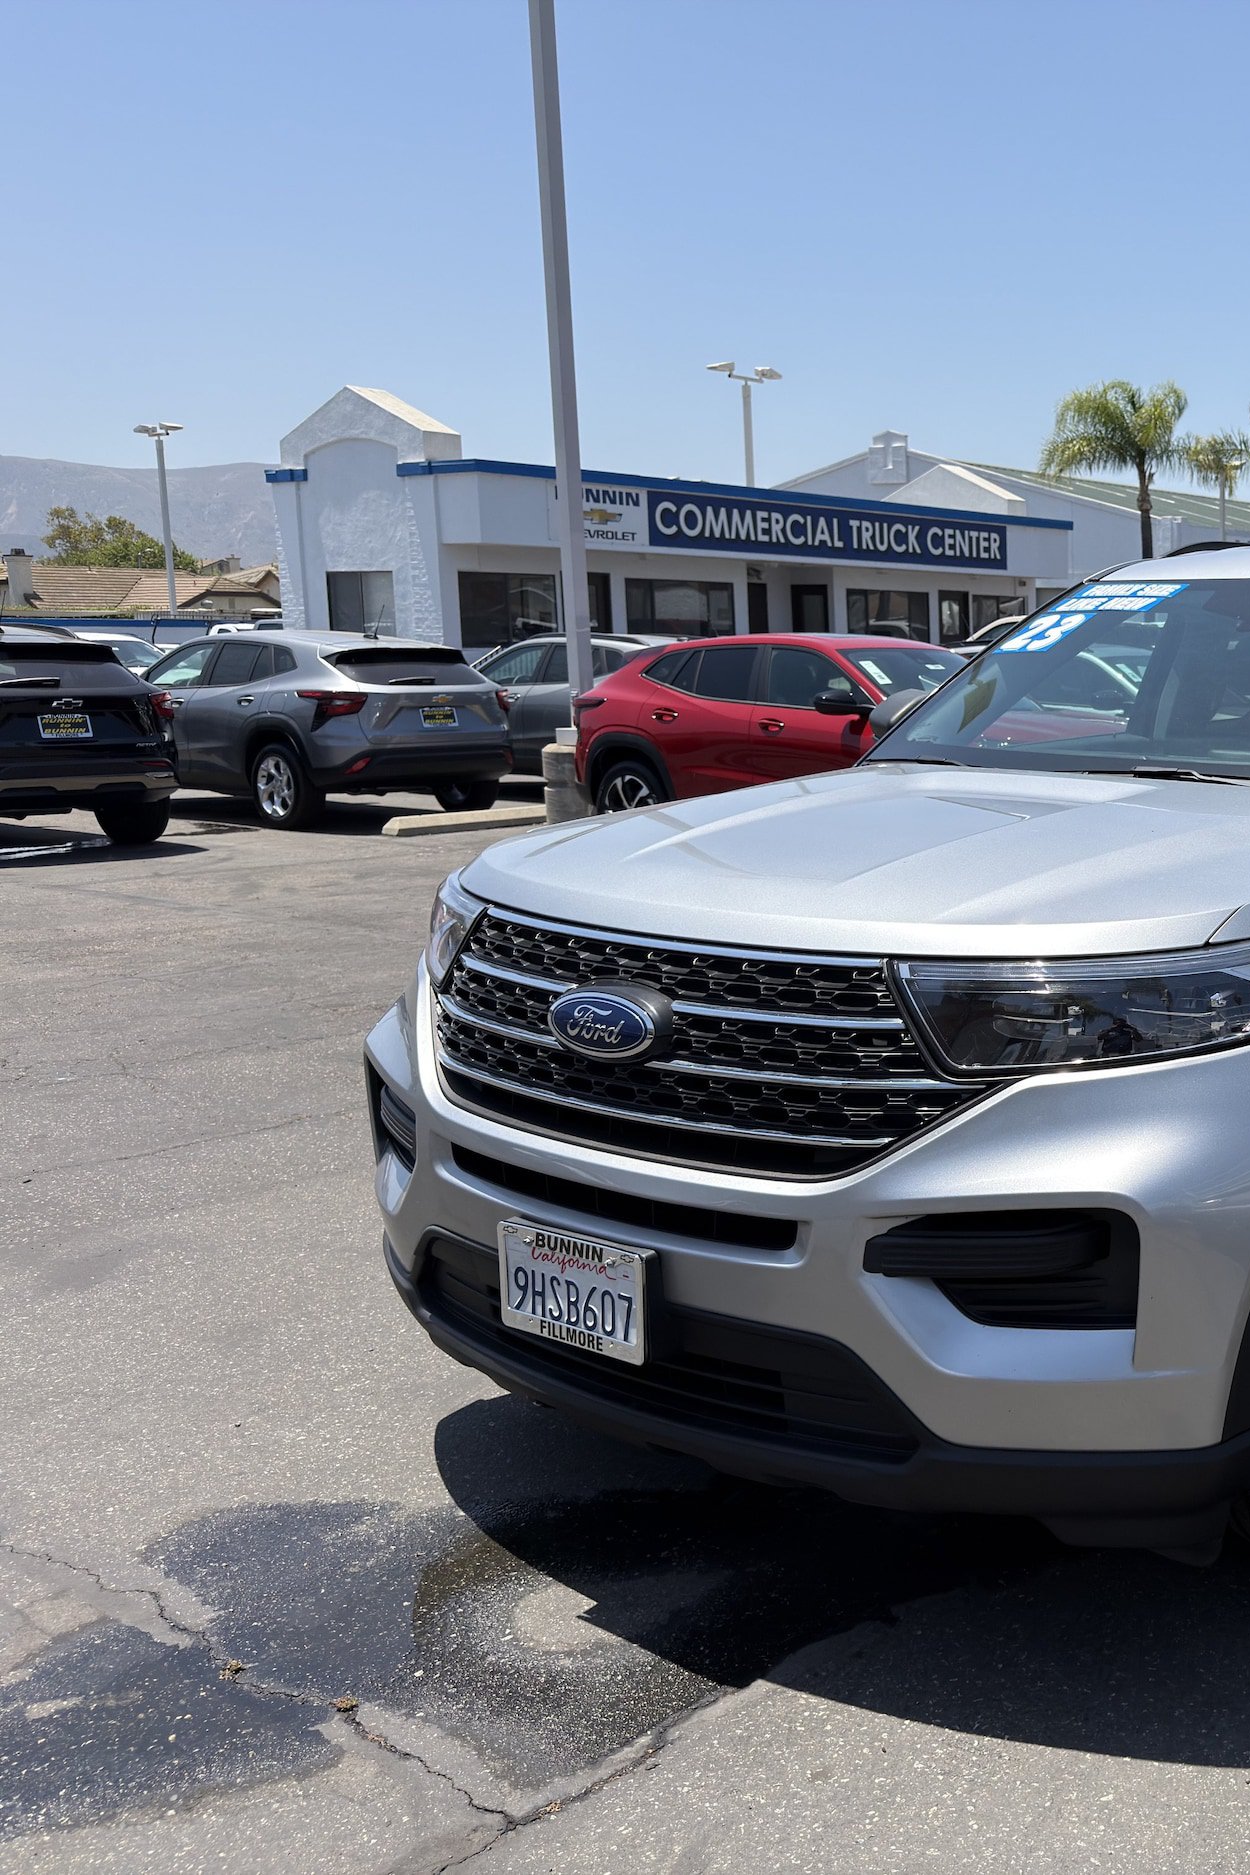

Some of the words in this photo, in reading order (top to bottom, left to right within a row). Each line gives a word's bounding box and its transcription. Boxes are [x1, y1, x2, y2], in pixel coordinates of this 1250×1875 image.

[584, 528, 638, 542] EVROLET
[653, 499, 844, 549] COMMERCIAL
[849, 518, 922, 555] TRUCK
[926, 526, 1002, 561] CENTER
[1055, 597, 1107, 612] LIKE
[1098, 597, 1155, 612] NEW
[1082, 583, 1143, 597] FAMILY
[1000, 613, 1087, 652] 23
[566, 1004, 626, 1045] Ford
[535, 1232, 604, 1262] BUNNIN
[531, 1247, 617, 1280] California
[514, 1266, 633, 1341] 9HSB607
[539, 1320, 604, 1352] FILLMORE
